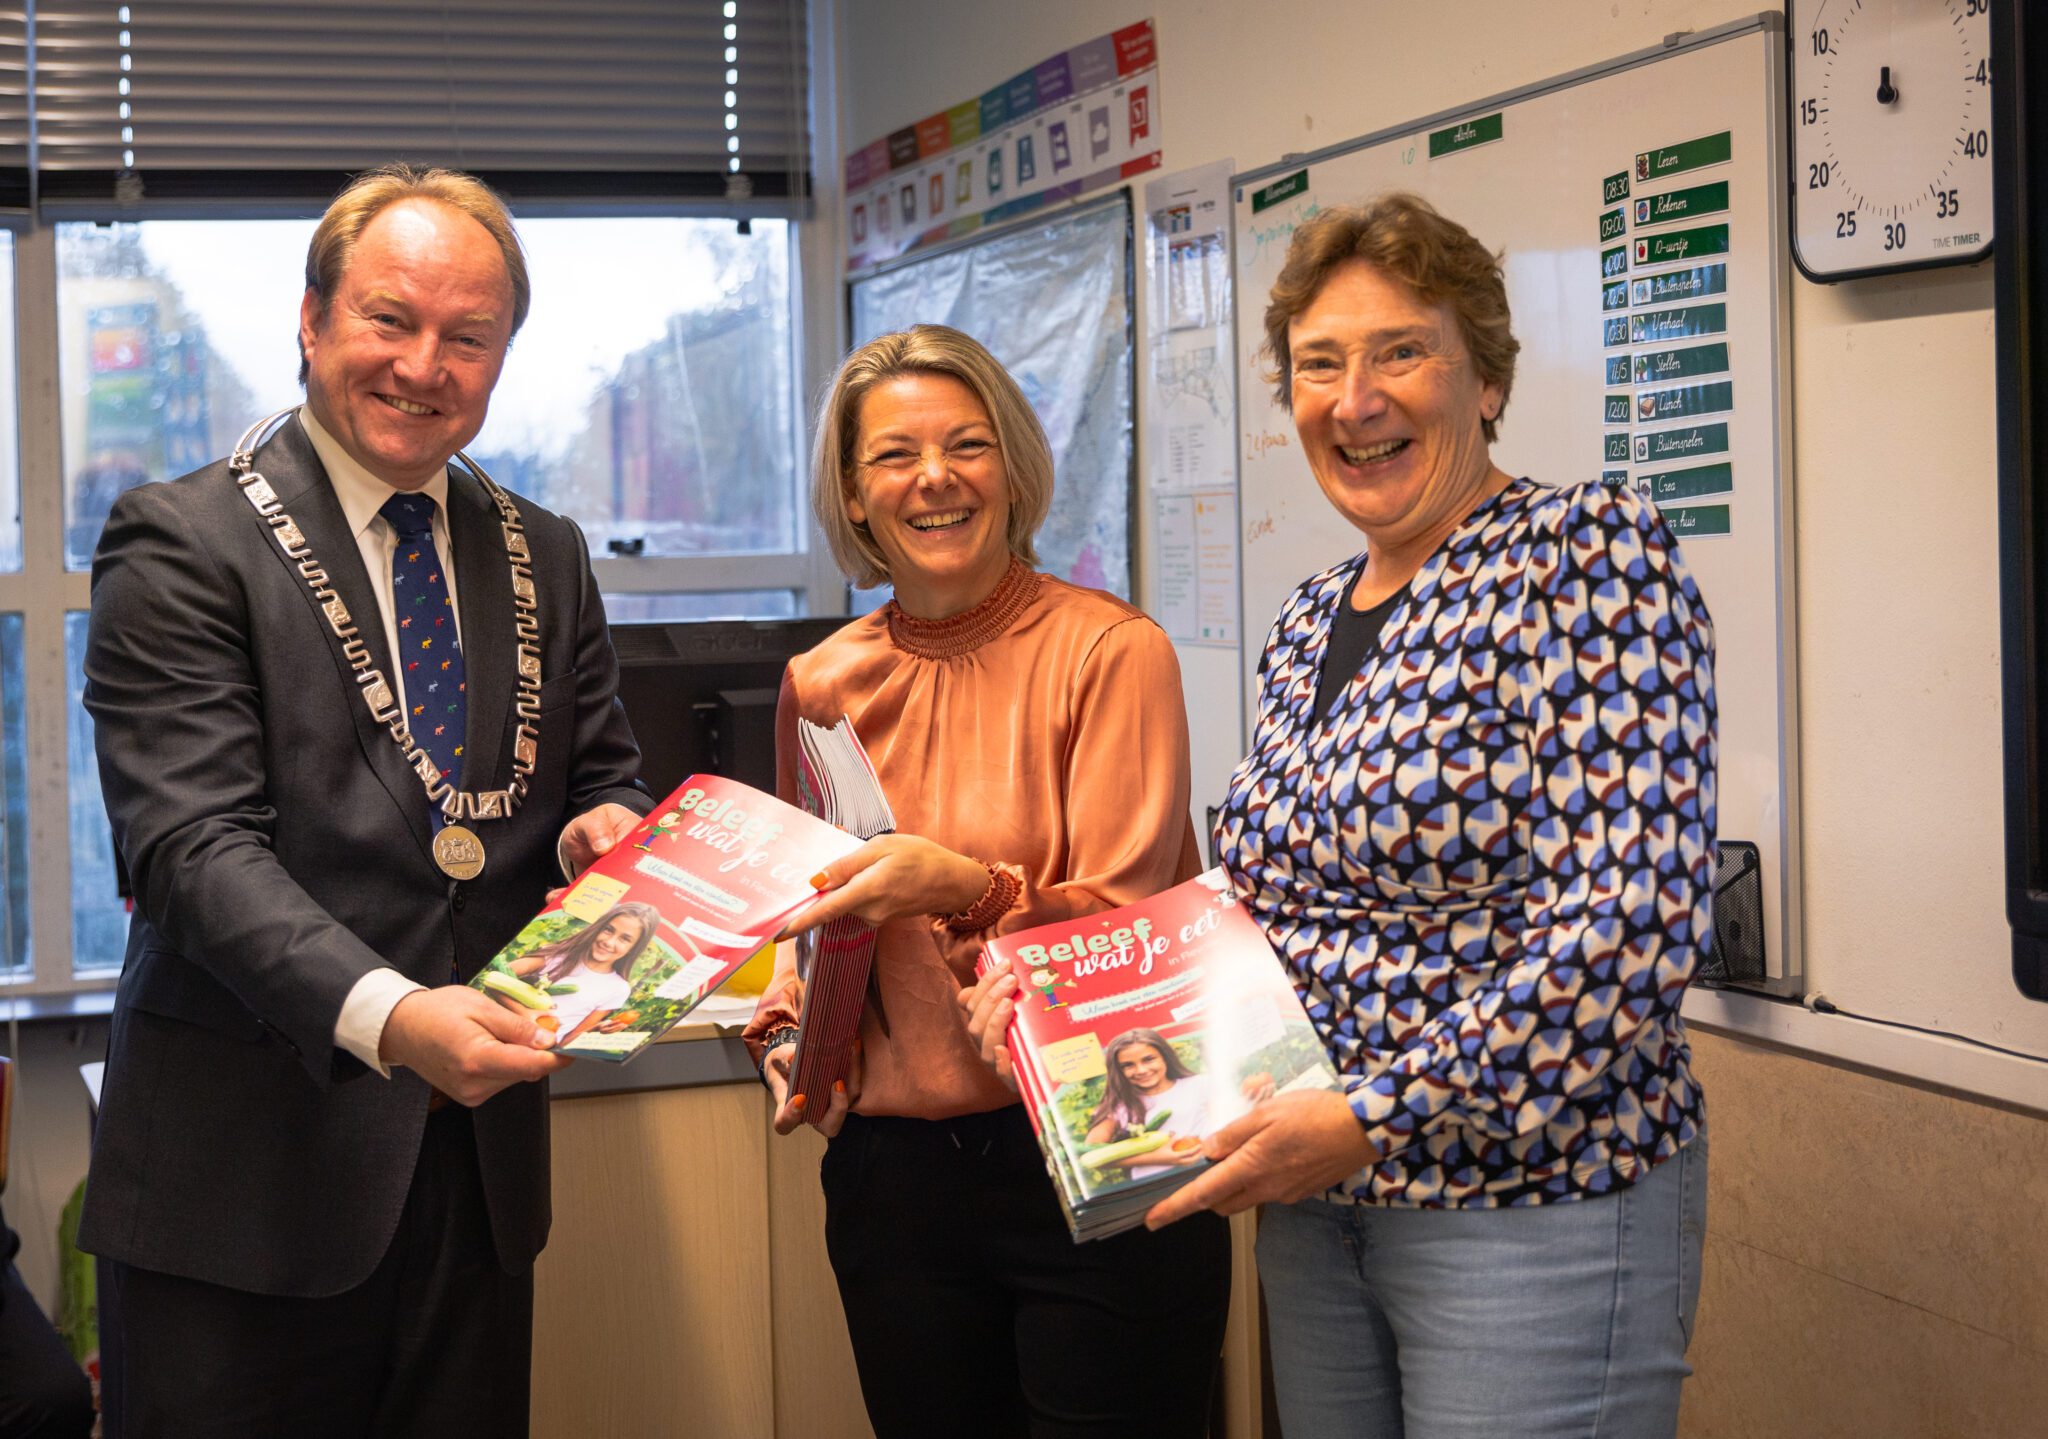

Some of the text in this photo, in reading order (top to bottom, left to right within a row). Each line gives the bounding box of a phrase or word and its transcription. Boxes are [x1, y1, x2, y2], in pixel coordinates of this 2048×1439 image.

[1812, 29, 1828, 56] 10
[1976, 58, 1991, 86] 4
[1801, 99, 1817, 126] 15
[1964, 130, 1988, 159] 40
[1605, 151, 1679, 200] 08:30 Lezen
[1809, 162, 1829, 189] 20
[1602, 194, 1688, 237] 09:00 Rekenen
[1936, 189, 1959, 219] 35
[1836, 211, 1857, 238] 25
[1884, 222, 1906, 251] 30
[1654, 237, 1689, 259] 10-uurtje
[1932, 232, 1982, 249] TIME TIMER
[1652, 310, 1687, 332] Verhaal
[1607, 392, 1682, 418] 12:00 Lunch
[1608, 429, 1704, 458] 12:15 Buitenspelen
[1658, 475, 1676, 493] Crea
[1680, 509, 1696, 528] huis
[679, 788, 784, 847] Beleef
[686, 821, 747, 854] wat
[1017, 917, 1153, 966] Beleef
[1073, 942, 1135, 978] wat
[1139, 934, 1171, 975] je
[1178, 907, 1222, 945] eet
